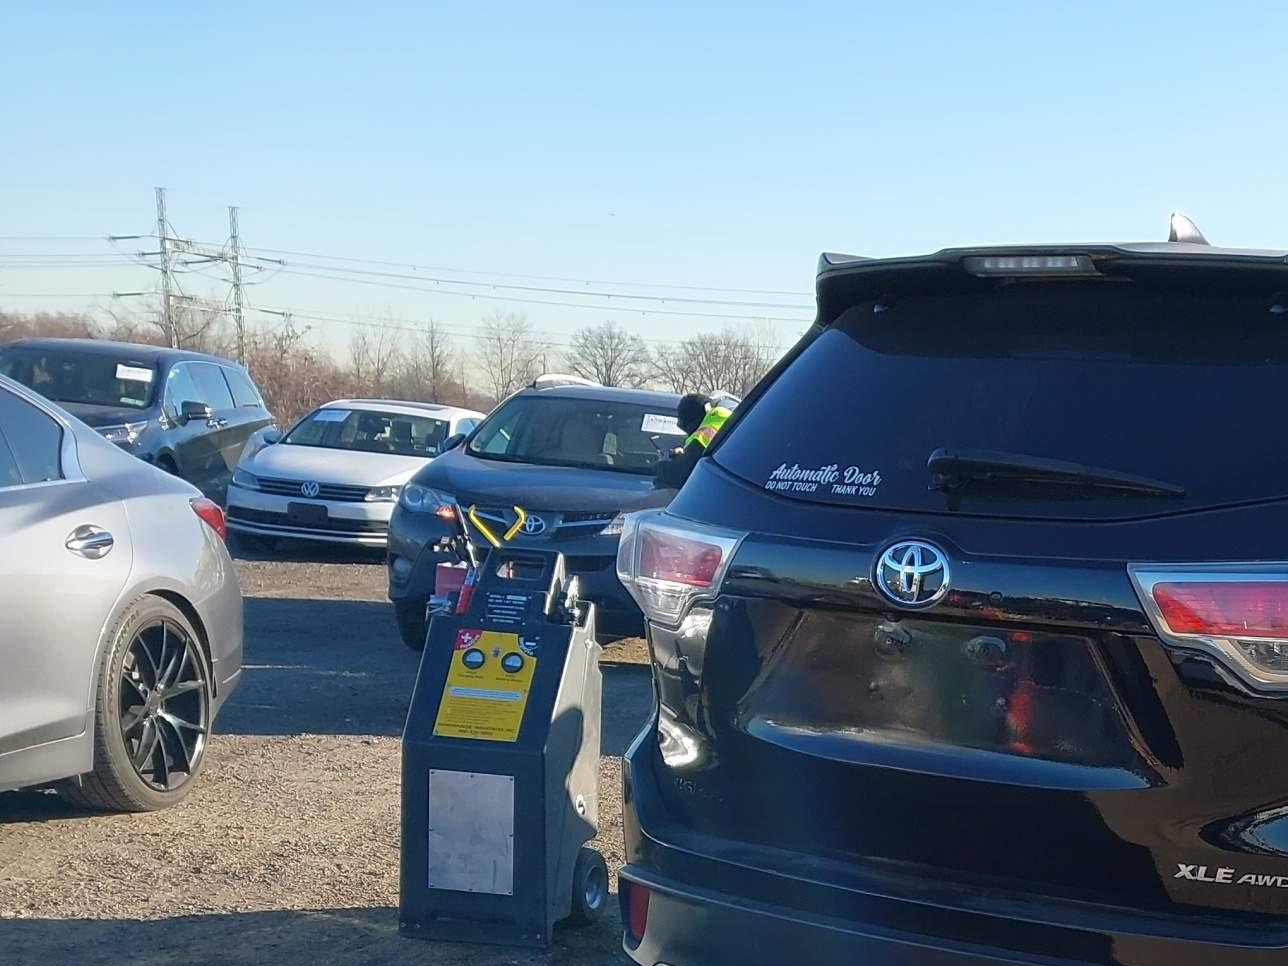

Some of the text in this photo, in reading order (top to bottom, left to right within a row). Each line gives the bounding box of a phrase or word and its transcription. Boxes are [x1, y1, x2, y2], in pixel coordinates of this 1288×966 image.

[769, 463, 882, 486] Automatic Door
[765, 480, 877, 497] DO NOT TOUCH THANK YOU
[1173, 863, 1236, 884] XLE
